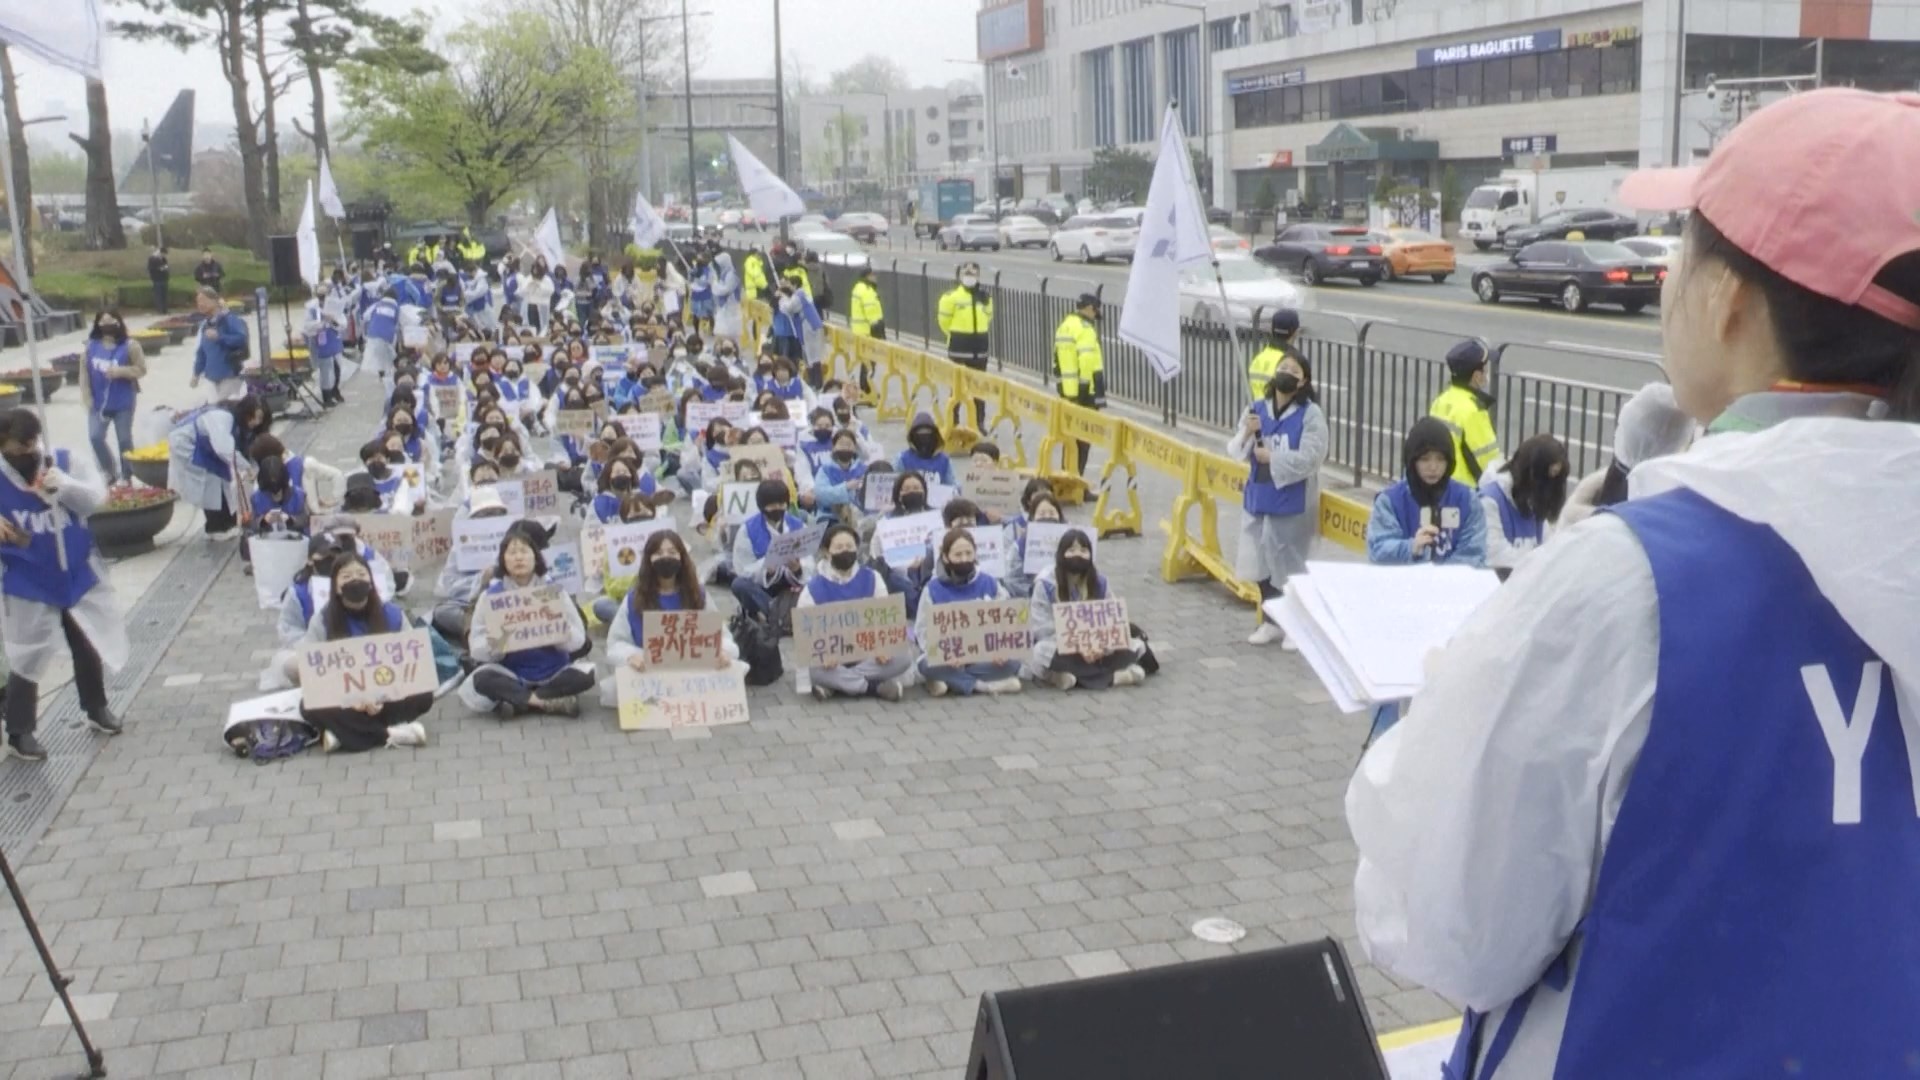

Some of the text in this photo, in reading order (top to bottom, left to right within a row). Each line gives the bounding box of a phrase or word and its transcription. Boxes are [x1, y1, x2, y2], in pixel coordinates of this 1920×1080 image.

[1434, 35, 1534, 62] PARIS BAGUETTE
[1324, 508, 1368, 539] POLICE
[661, 612, 699, 636] 방류
[933, 606, 1017, 634] 방사능 오염수
[306, 639, 424, 677] 방사능 오염수
